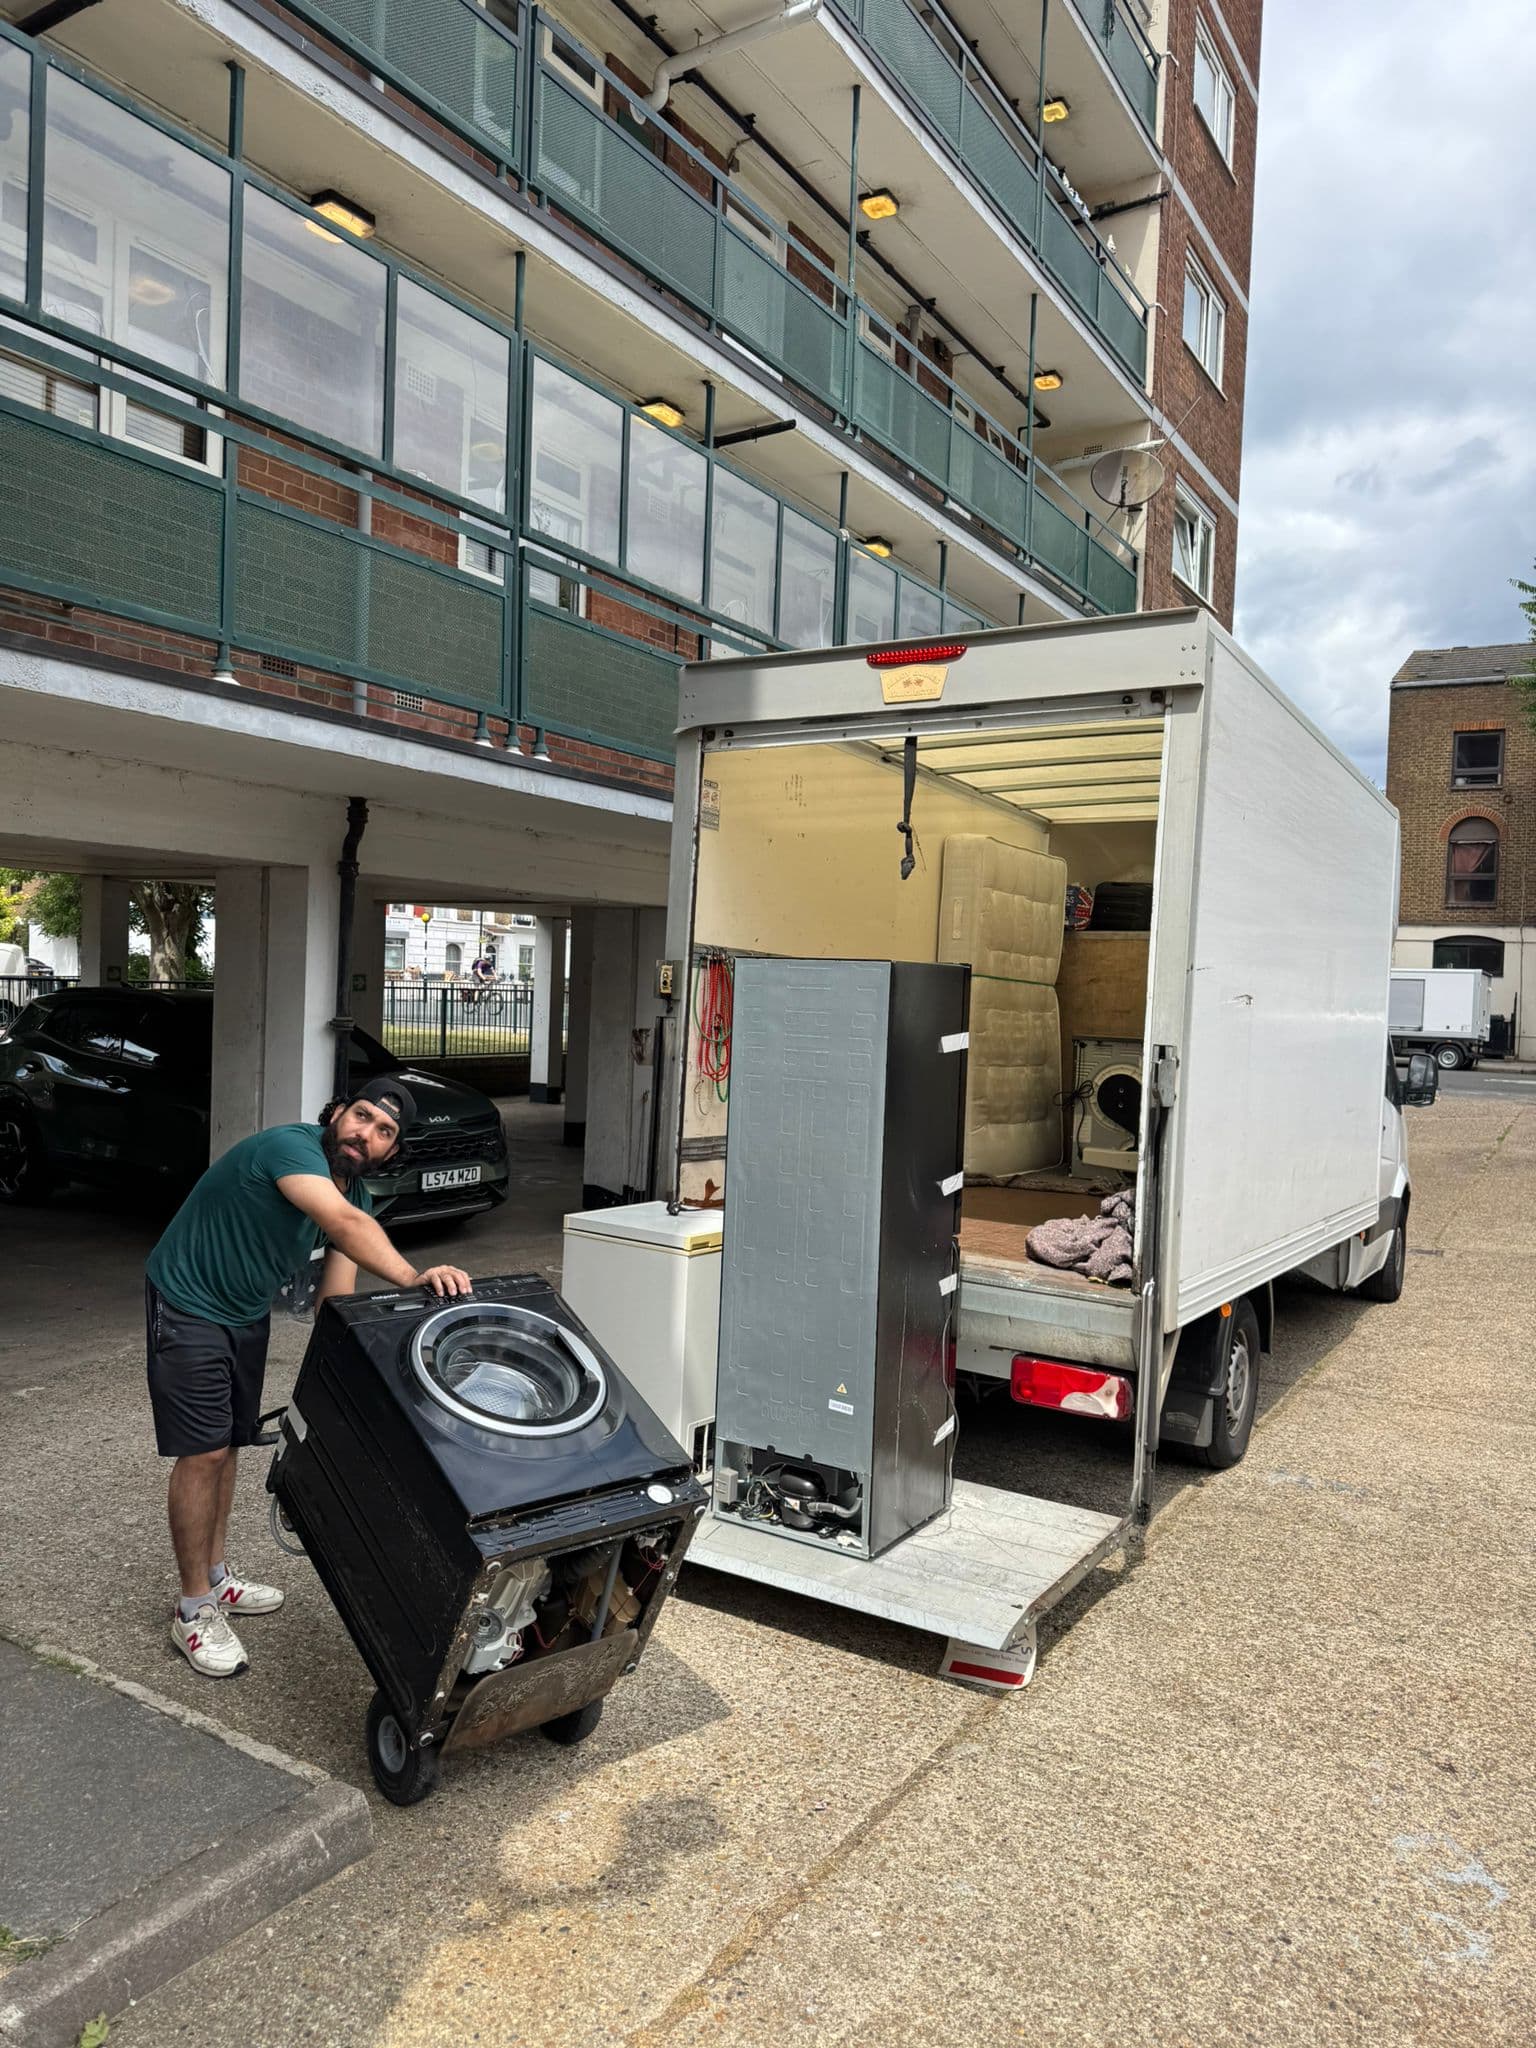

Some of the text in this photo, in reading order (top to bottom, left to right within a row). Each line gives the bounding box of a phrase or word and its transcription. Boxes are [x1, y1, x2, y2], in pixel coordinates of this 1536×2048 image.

[426, 1171, 454, 1186] LS74
[220, 1587, 244, 1604] N
[186, 1632, 203, 1652] N
